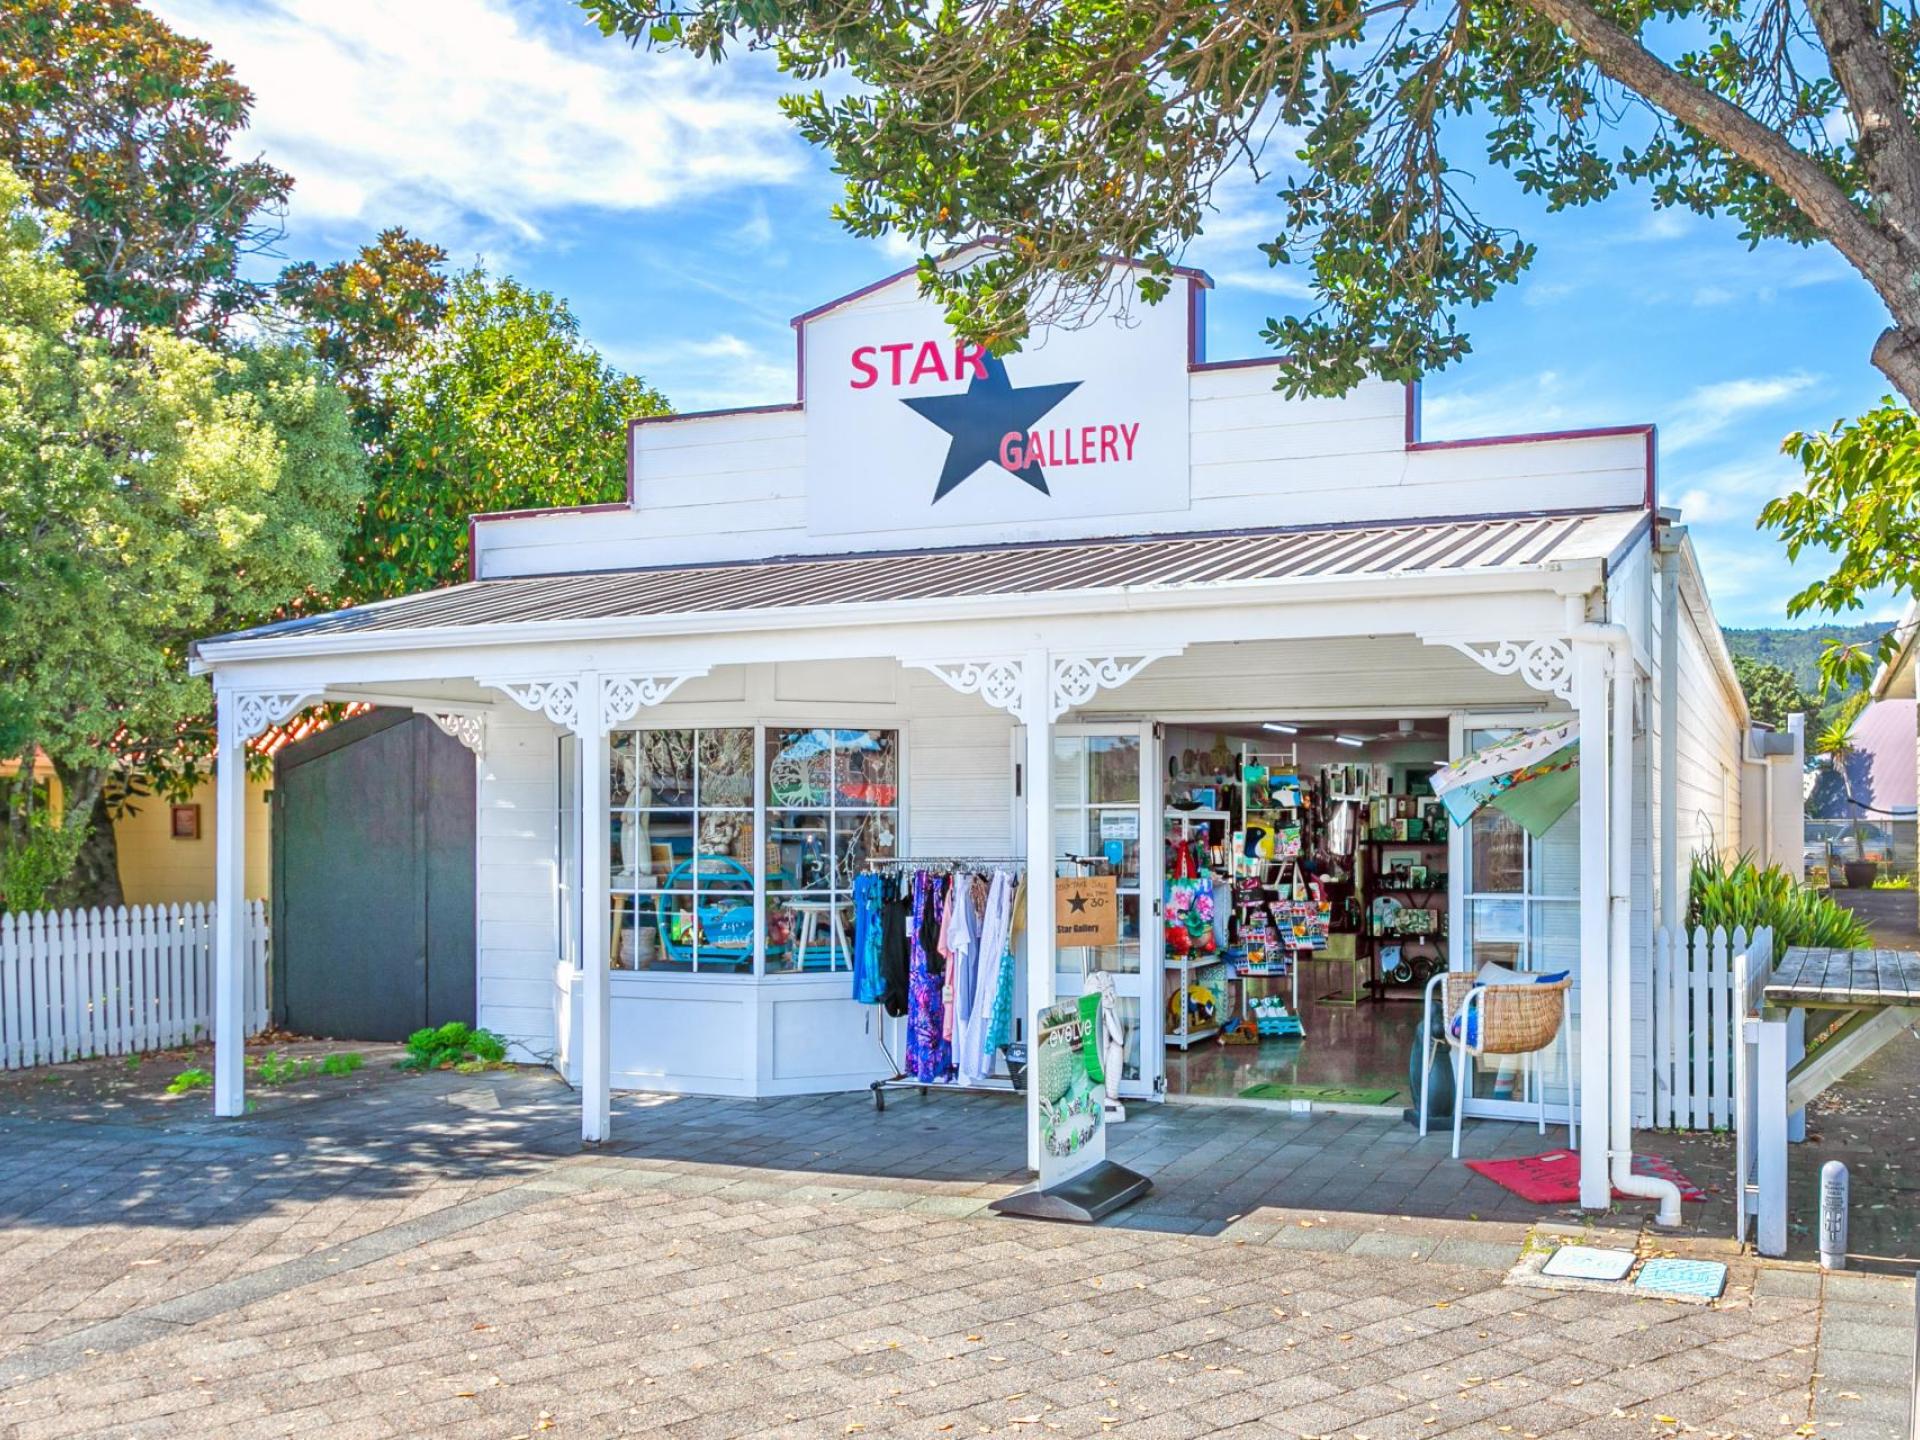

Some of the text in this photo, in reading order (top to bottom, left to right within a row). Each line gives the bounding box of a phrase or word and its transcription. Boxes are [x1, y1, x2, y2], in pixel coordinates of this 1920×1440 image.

[850, 339, 989, 389] STAR
[1000, 422, 1140, 472] GALLERY
[1056, 924, 1099, 934] Star Gallery
